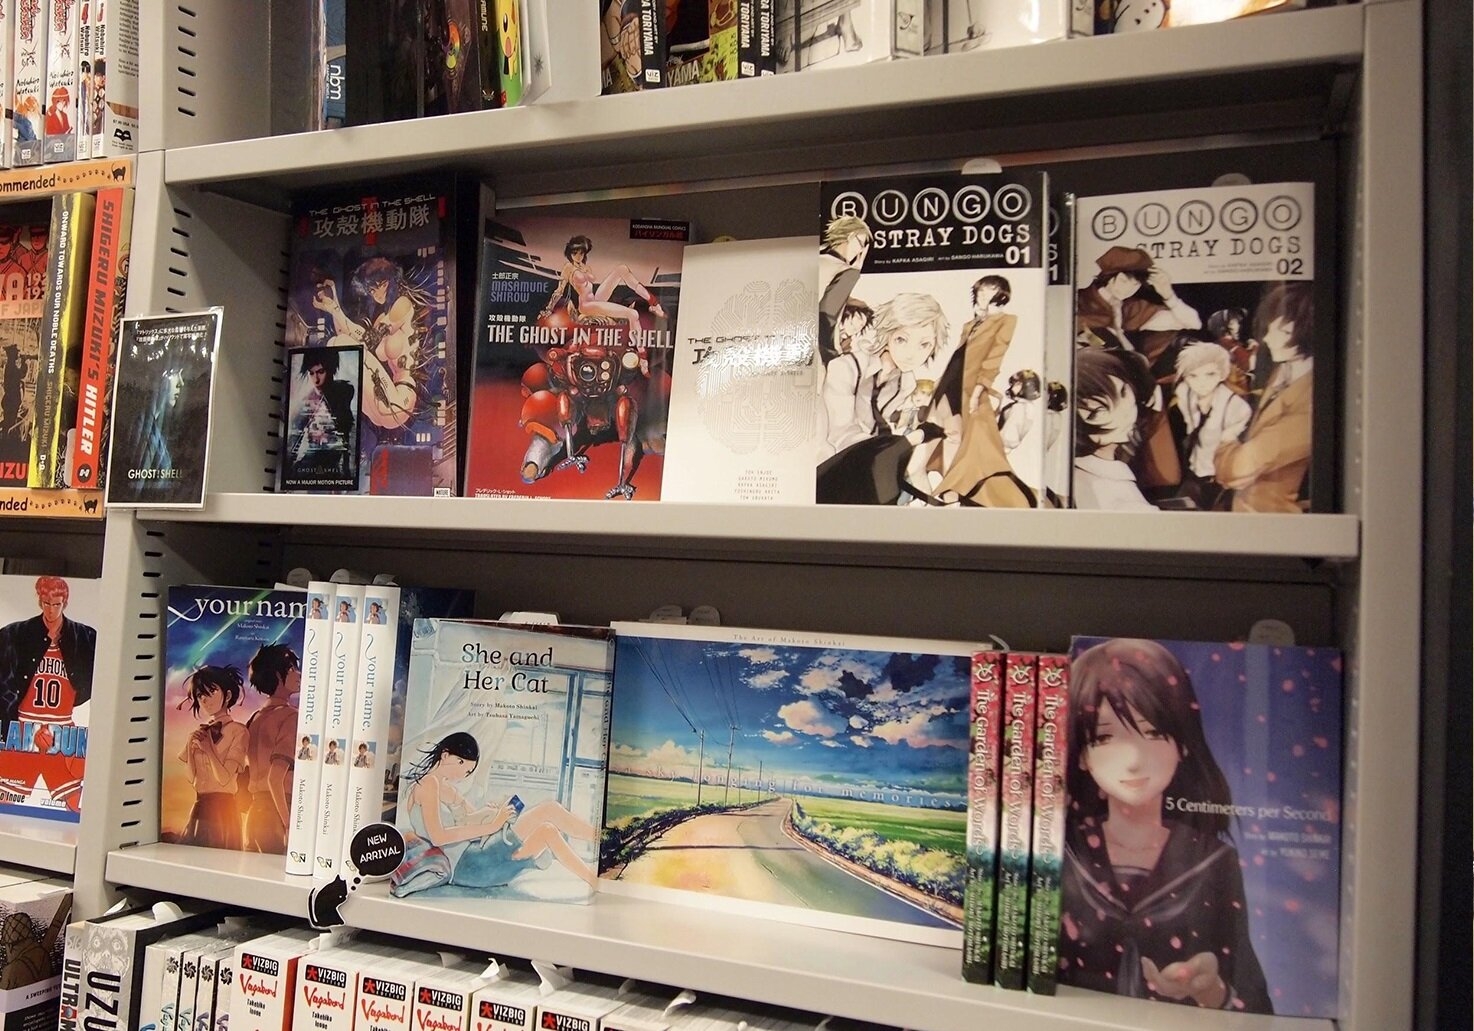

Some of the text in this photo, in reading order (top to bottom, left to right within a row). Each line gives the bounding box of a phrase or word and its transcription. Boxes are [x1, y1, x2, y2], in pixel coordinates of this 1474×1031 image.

[641, 8, 654, 56] TORIYAMA
[330, 64, 344, 100] nbm
[833, 186, 1029, 225] BUNGO
[313, 205, 431, 238] 攻殻機動隊
[1094, 198, 1300, 240] BUNGO
[874, 224, 1030, 249] STRAY DOGS
[1005, 245, 1030, 265] 01
[1276, 258, 1304, 275] 02
[47, 211, 69, 375] ONWARD TOWARDS OUR NOBLE DEATHS
[490, 291, 530, 304] SHIROW
[491, 280, 549, 294] MASAMUNE
[80, 200, 115, 456] SHIGERU MIZUKI'S HITLER
[487, 324, 674, 350] THE GHOST IN THE SHELL
[128, 468, 157, 480] GHOST
[461, 642, 553, 667] She and
[33, 678, 61, 710] 10
[361, 655, 377, 732] your name.
[463, 670, 549, 694] Her Cat
[976, 690, 988, 716] The
[974, 716, 989, 769] Garden
[1165, 797, 1175, 810] 5
[1177, 798, 1255, 816] Centimeters
[1258, 806, 1280, 819] per
[366, 833, 388, 847] NEW
[970, 800, 987, 857] Words
[359, 846, 401, 866] ARRIVAL
[252, 954, 279, 972] VIZBIG
[316, 967, 347, 983] VIZBIG
